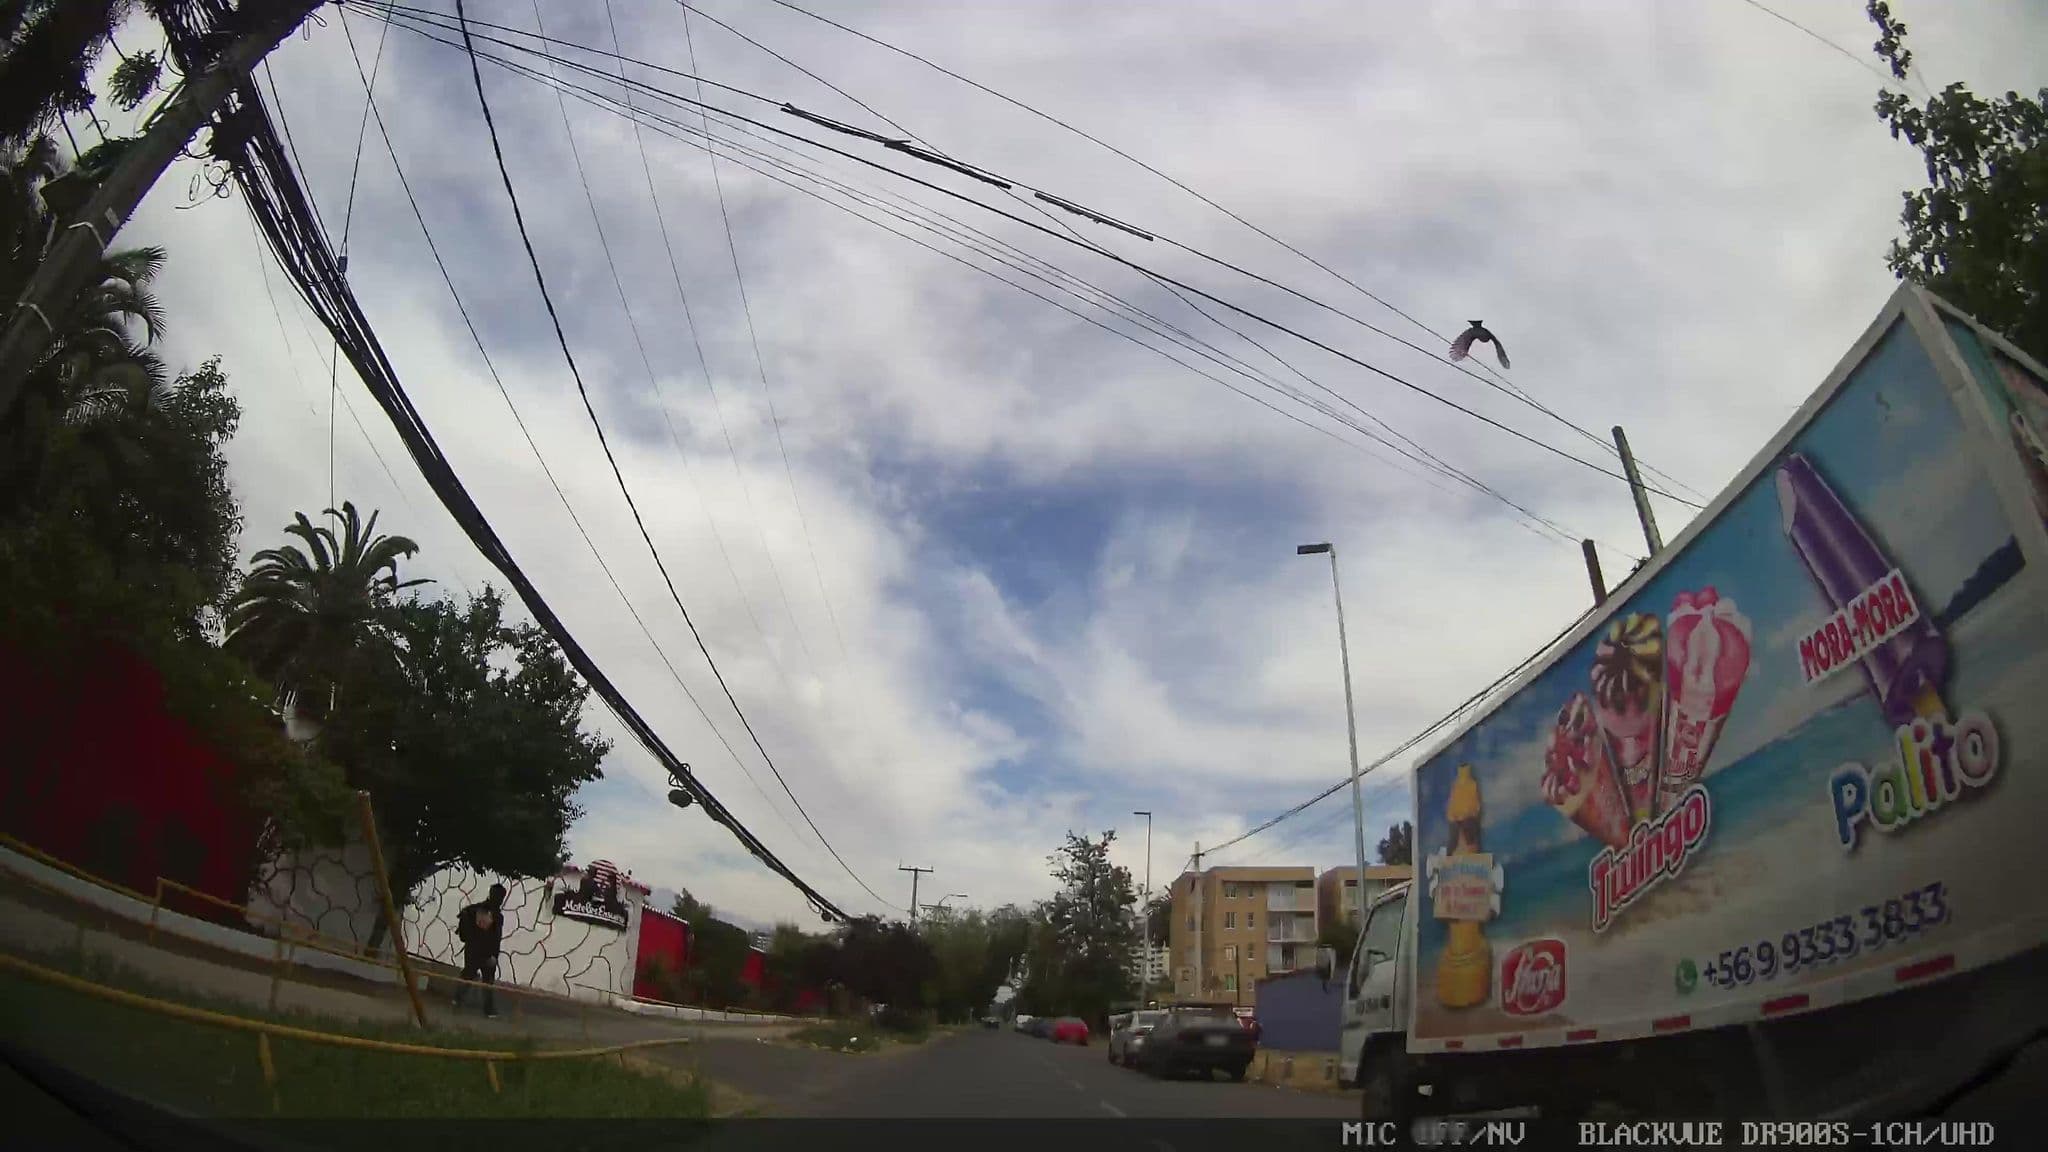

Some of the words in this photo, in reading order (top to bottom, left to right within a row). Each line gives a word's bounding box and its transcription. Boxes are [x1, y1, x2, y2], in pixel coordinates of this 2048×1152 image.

[1799, 574, 1914, 683] MORA-MORA
[1830, 711, 1997, 847] Palito
[1590, 788, 1708, 928] Twingo
